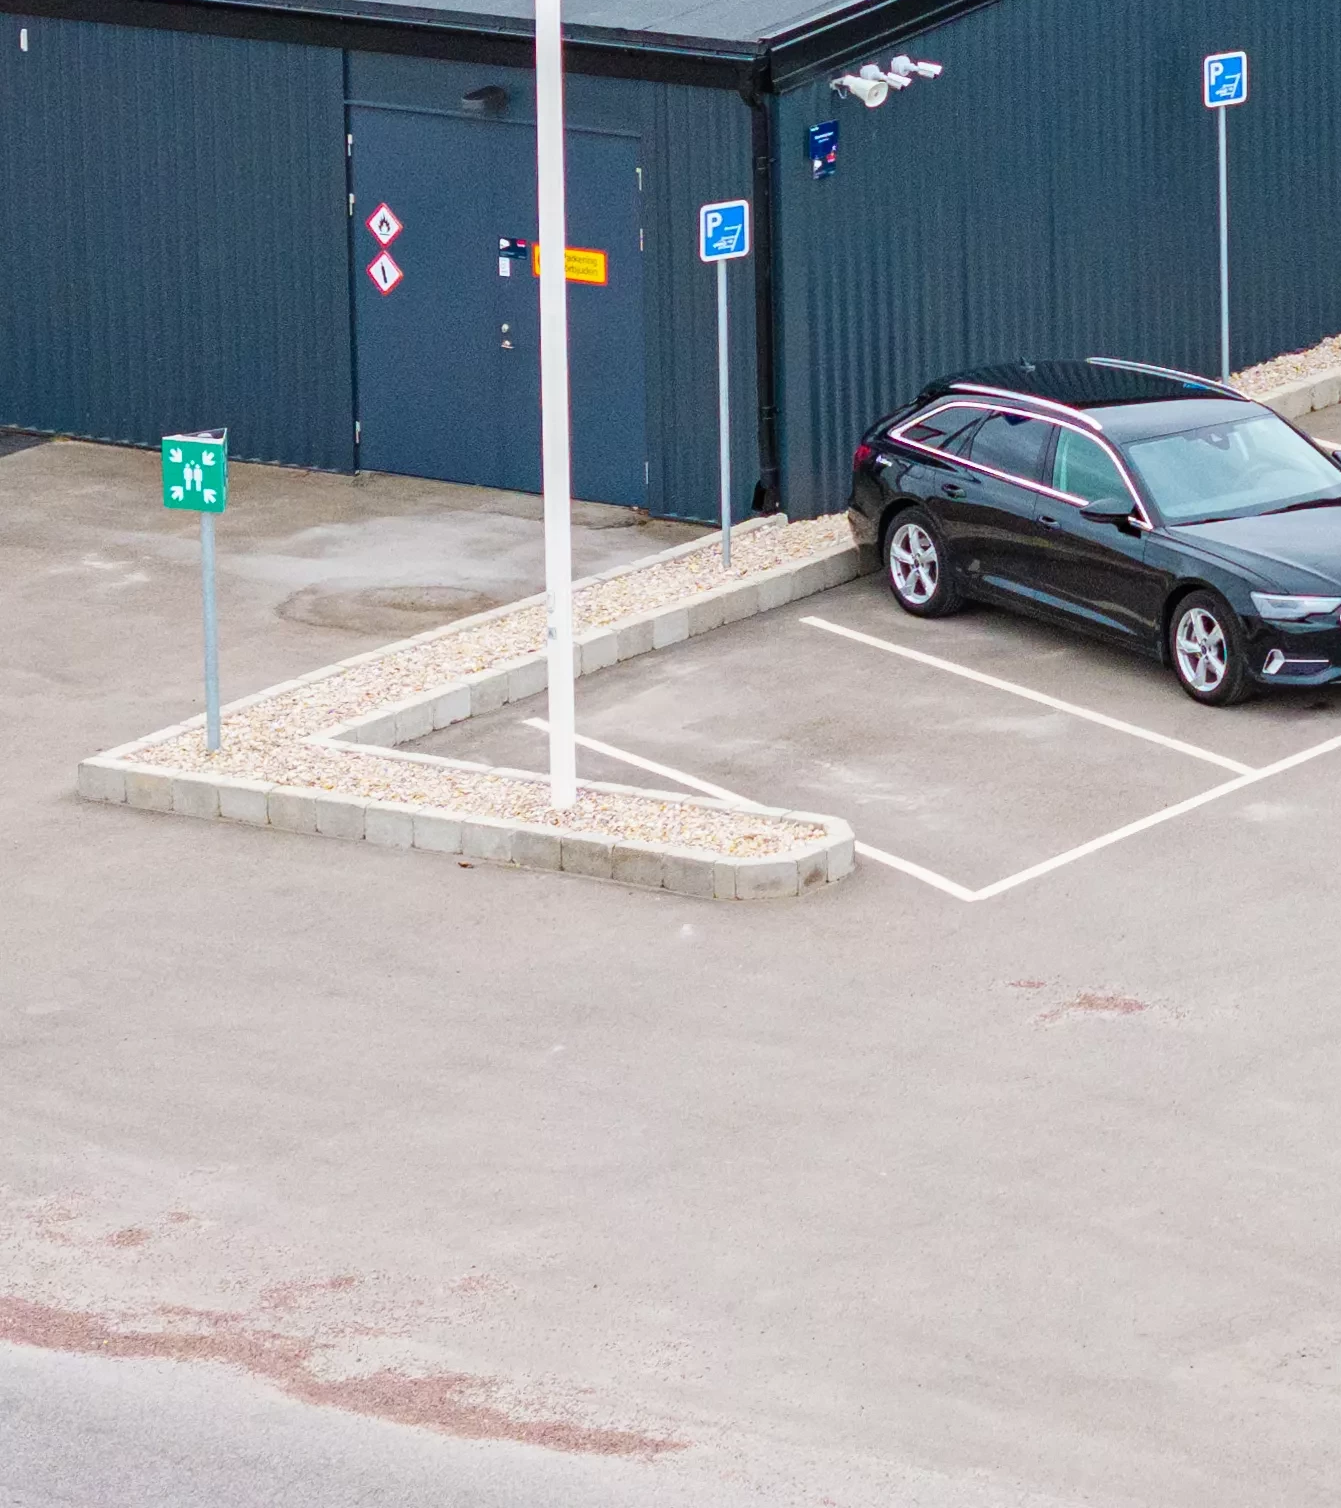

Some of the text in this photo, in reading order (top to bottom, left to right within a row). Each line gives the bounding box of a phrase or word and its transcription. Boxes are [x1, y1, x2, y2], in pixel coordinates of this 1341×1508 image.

[1210, 62, 1224, 86] P
[706, 212, 723, 238] P
[564, 253, 598, 267] arkering
